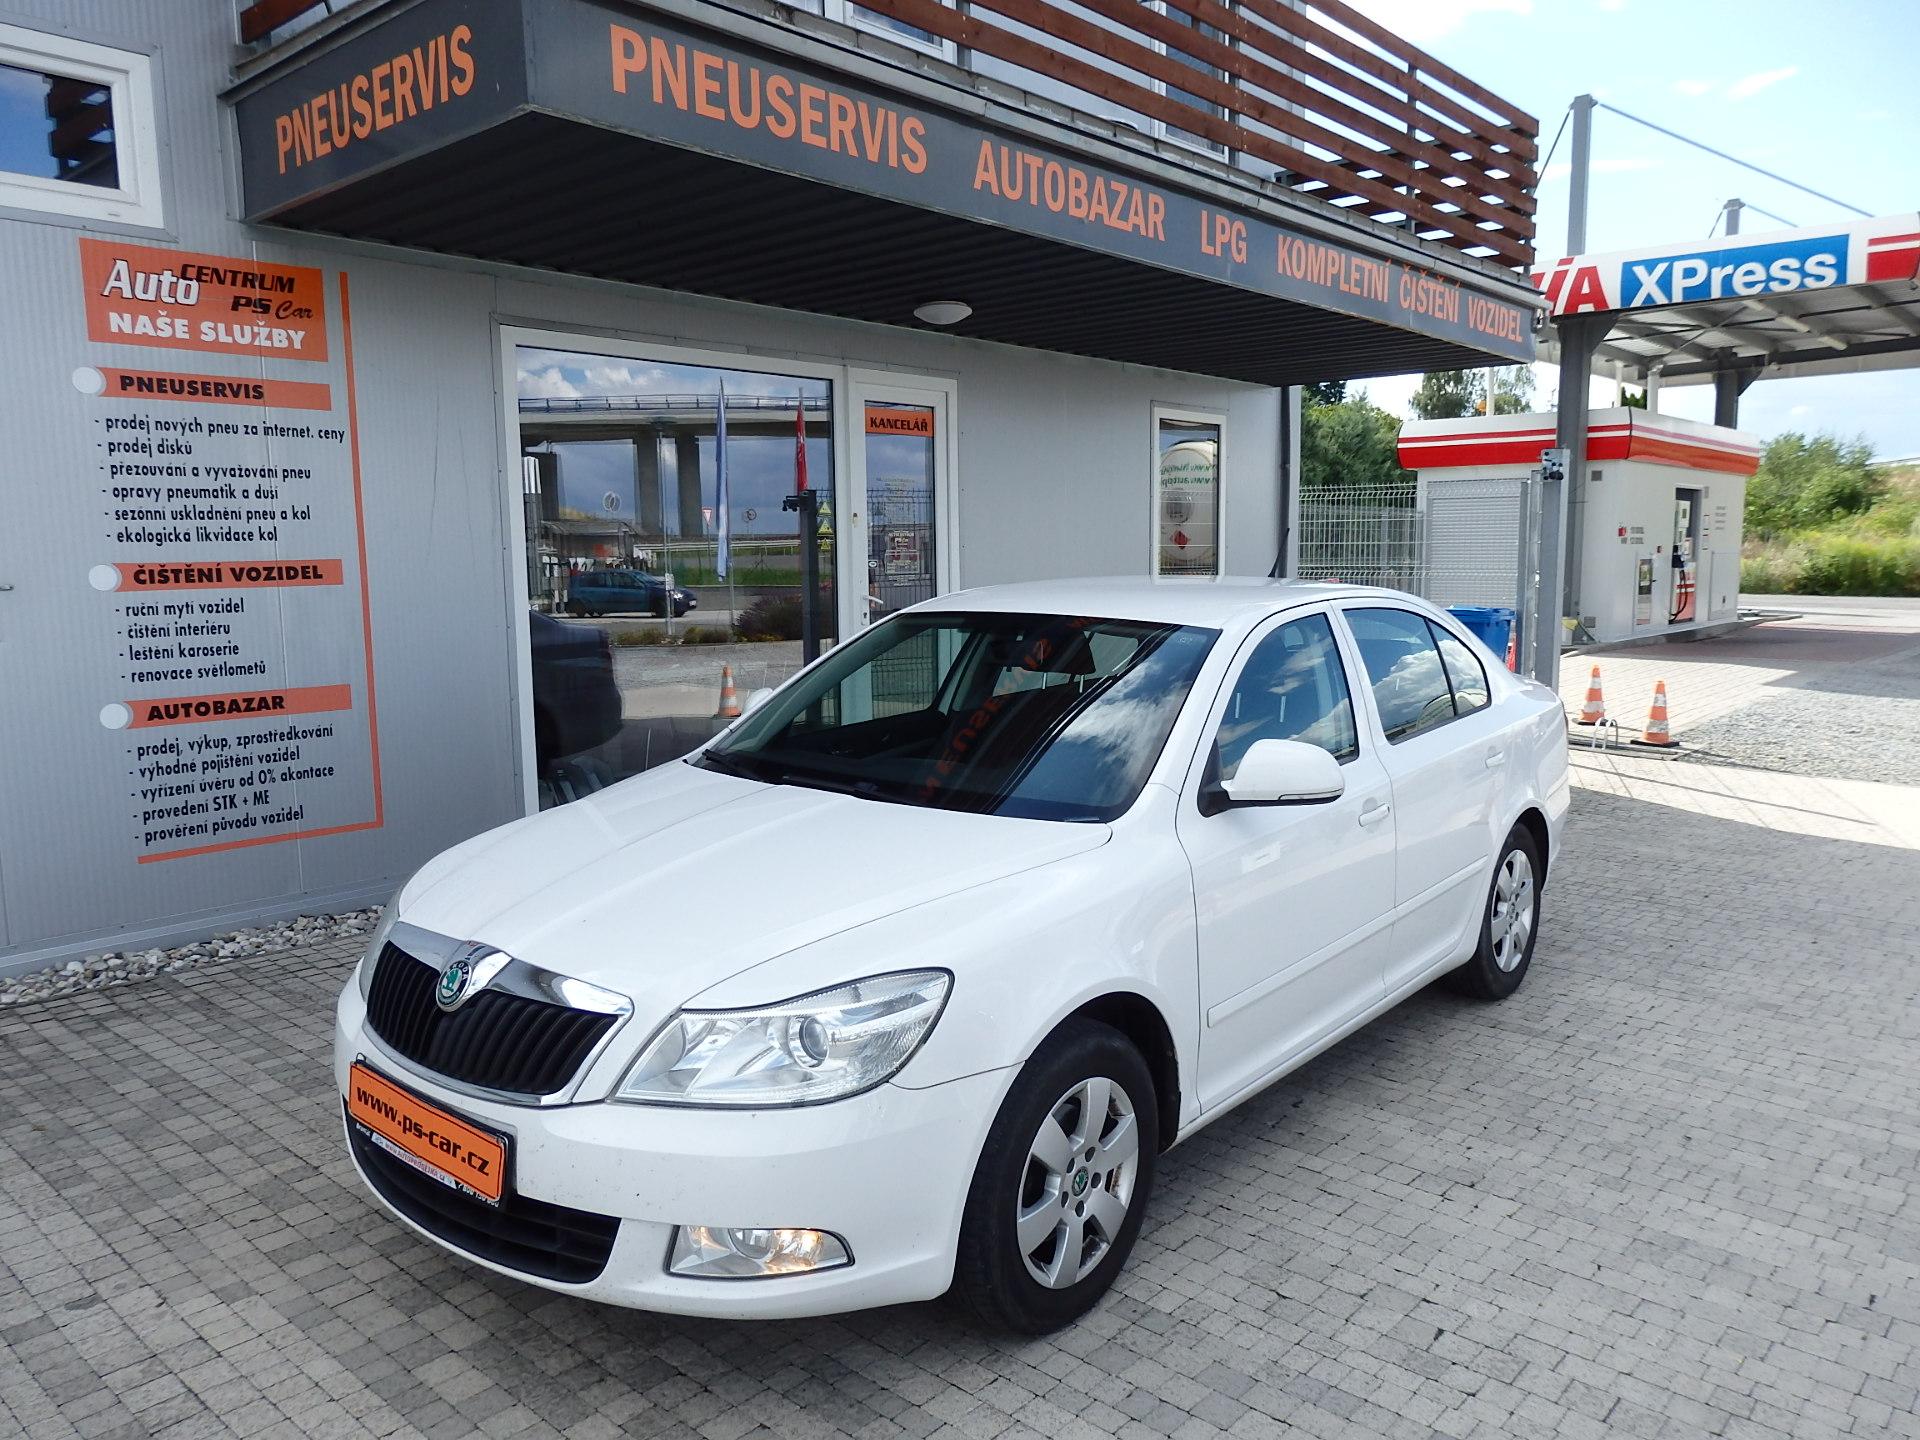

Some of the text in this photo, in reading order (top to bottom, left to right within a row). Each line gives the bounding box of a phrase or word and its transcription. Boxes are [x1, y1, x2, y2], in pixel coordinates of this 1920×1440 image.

[275, 23, 475, 174] PNEUSERVIS
[609, 23, 1523, 344] PNEUSERVIS AUTOBAZAR LPG KOMPLETNÍ ČIŠTĚNÍ VOZIDEL
[100, 258, 296, 306] Auto CENTRUM
[1629, 252, 1838, 308] XPress
[230, 295, 314, 320] PS Car
[108, 309, 306, 350] NAŠE SLUŽBY
[119, 374, 265, 400] PNEUSERVIS
[105, 413, 345, 444] prodej nových pneu za internet. ceny
[869, 416, 929, 432] KANCELÁŘ
[107, 436, 152, 458] prodej
[110, 461, 311, 483] přezouvání a vyvažování pneu
[112, 486, 162, 502] opravy
[166, 484, 237, 502] pneumatik
[242, 488, 250, 500] a
[170, 504, 242, 521] uskladnění
[246, 508, 276, 524] pneu
[280, 509, 288, 520] a
[292, 504, 311, 521] kol
[116, 525, 278, 546] ekologická likvidace kol
[132, 562, 324, 585] ČIŠTĚNÍ VOZIDEL
[125, 597, 245, 619] ruční mytí vozidel
[127, 619, 231, 639] čištění interiéru
[129, 640, 240, 661] leštění karoserie
[131, 660, 266, 683] renovace světlometů
[147, 694, 286, 722] AUTOBAZAR
[137, 723, 334, 761] prodej, výkup, zprostředkování
[138, 745, 300, 782] výhodné pojištění vozidel
[140, 765, 335, 803] vyřízení úvěru od 0% akontace
[142, 800, 209, 826] provedení
[213, 793, 238, 812] STK
[253, 789, 270, 806] ME
[144, 804, 304, 847] prověření původu vozidel
[356, 1085, 490, 1177] www.ps-car.cz
